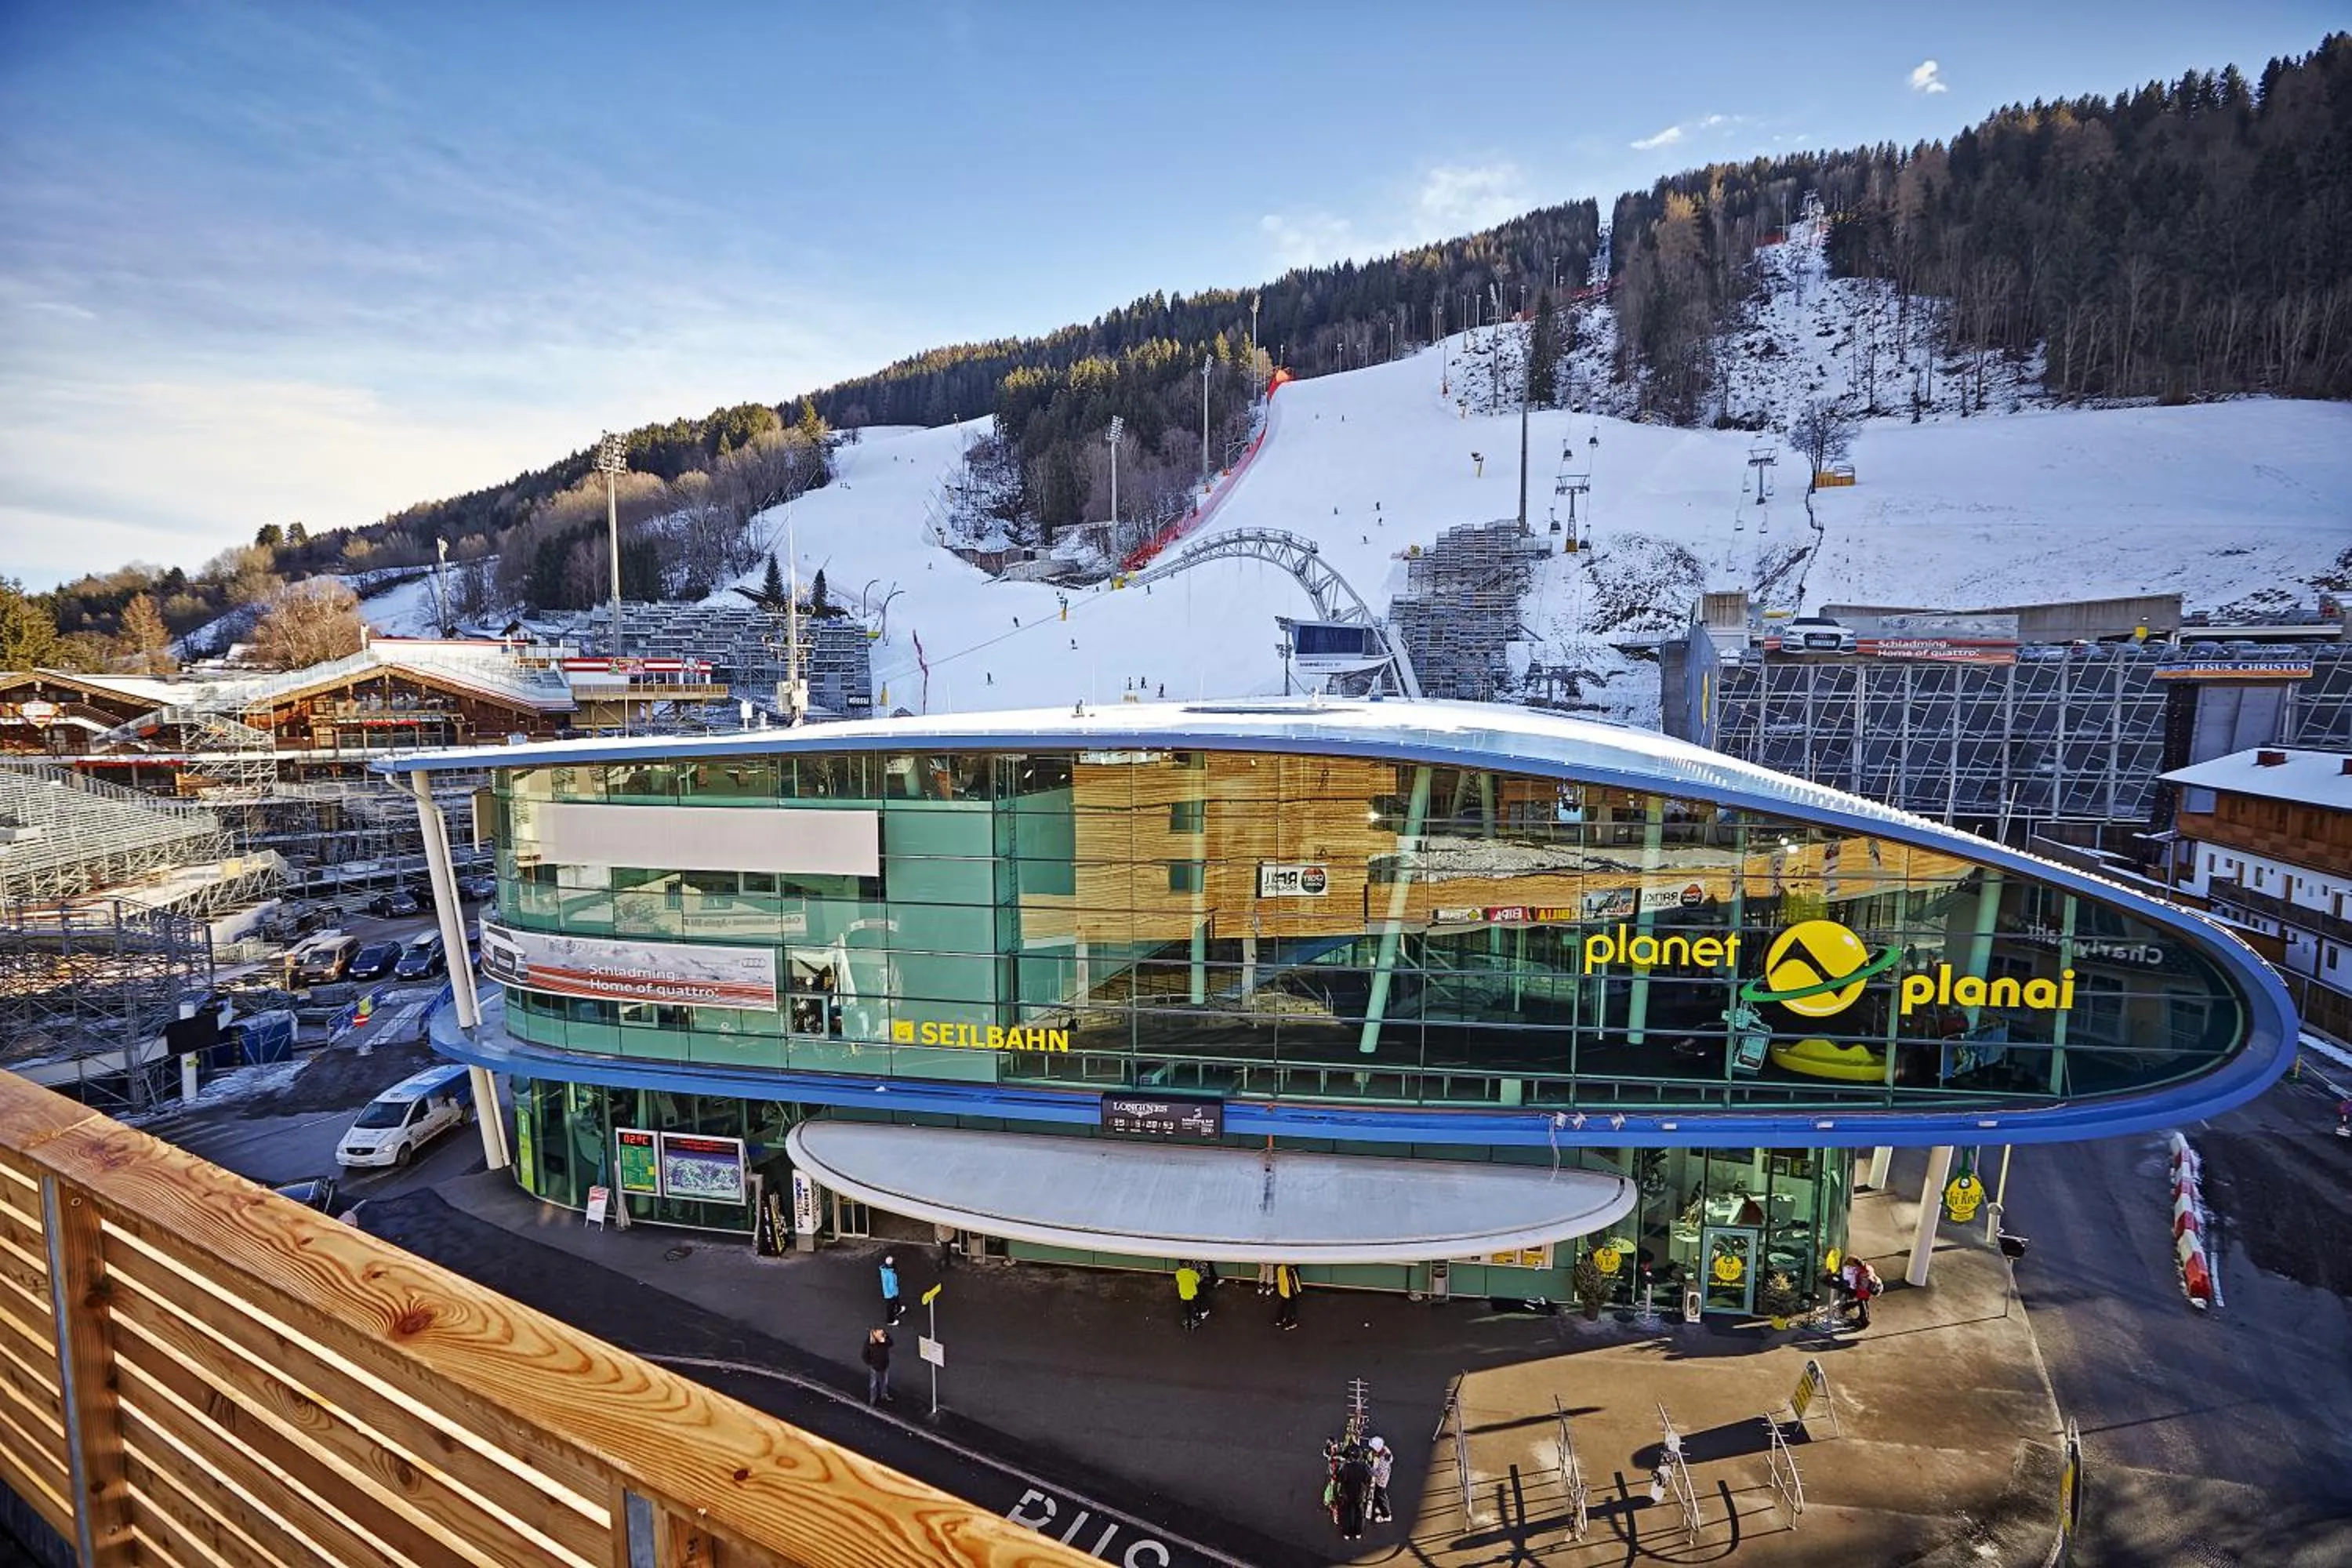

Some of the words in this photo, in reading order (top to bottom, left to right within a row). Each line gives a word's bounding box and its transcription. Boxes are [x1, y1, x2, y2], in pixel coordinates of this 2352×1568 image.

[2194, 662, 2233, 672] JESUS
[2238, 662, 2309, 672] CHRISTUS
[1584, 923, 1741, 975] planet
[590, 978, 633, 992] Home
[636, 982, 653, 994] of
[1900, 964, 2076, 1014] planai
[920, 1021, 1069, 1053] SEILBAHN
[1112, 1102, 1169, 1113] LONGINES
